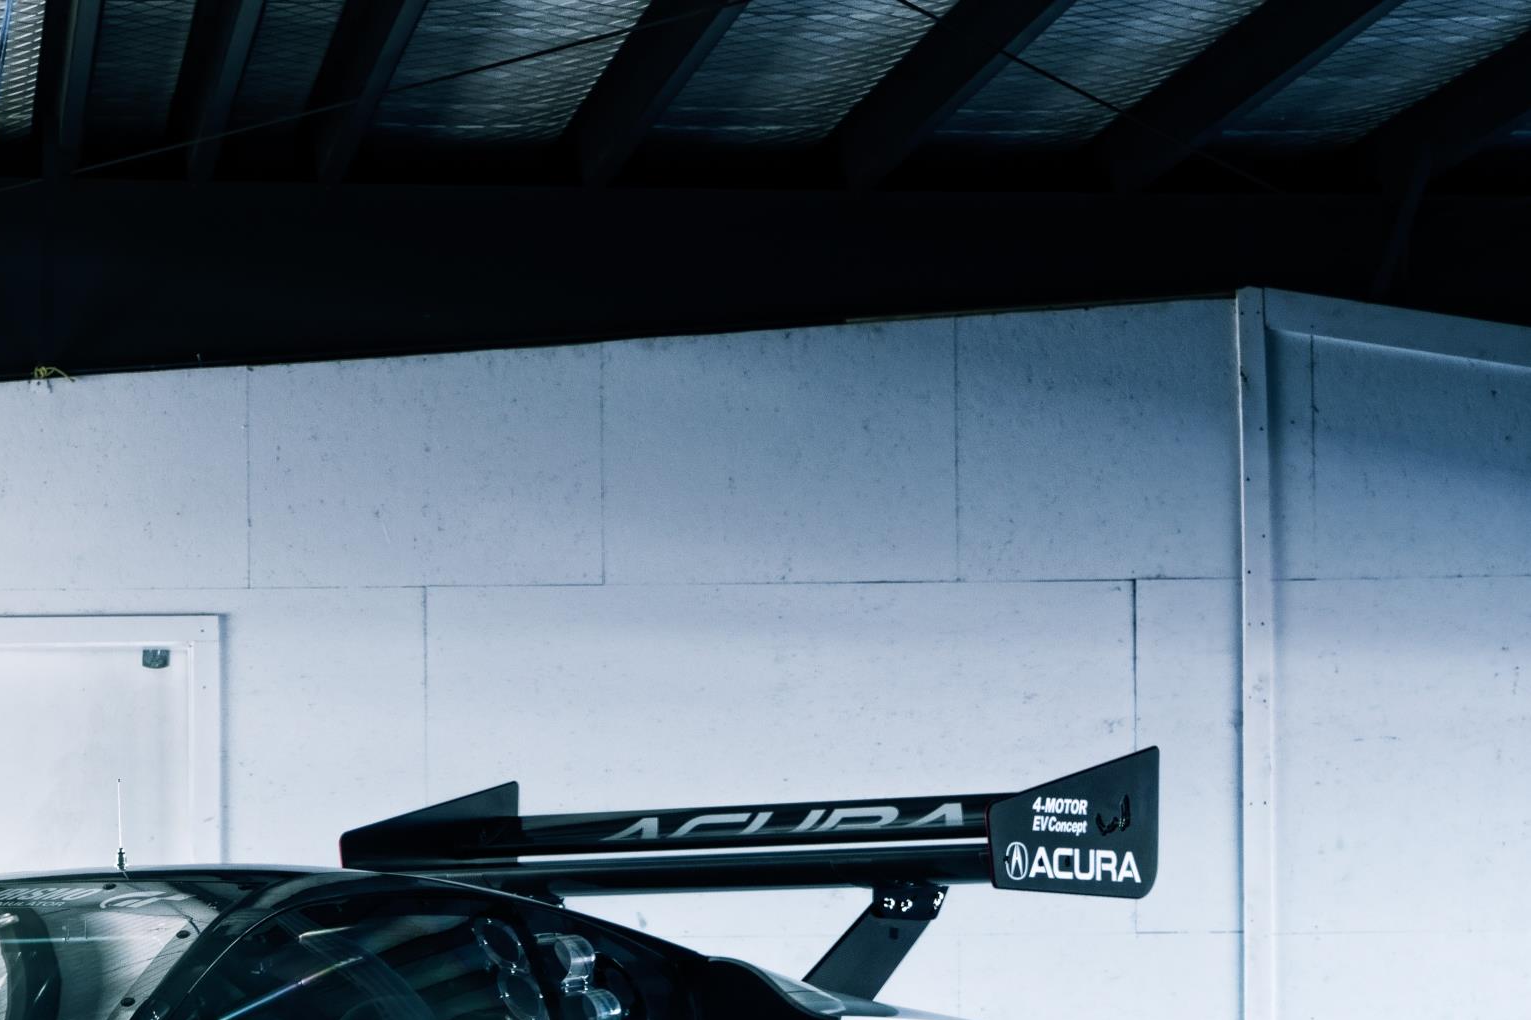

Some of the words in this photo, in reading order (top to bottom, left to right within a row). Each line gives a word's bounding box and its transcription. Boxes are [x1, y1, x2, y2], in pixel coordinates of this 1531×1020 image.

[1032, 796, 1088, 815] 4-MOTOR
[1032, 815, 1050, 831] EV
[1049, 816, 1087, 836] Concept
[1029, 846, 1142, 883] ACURA
